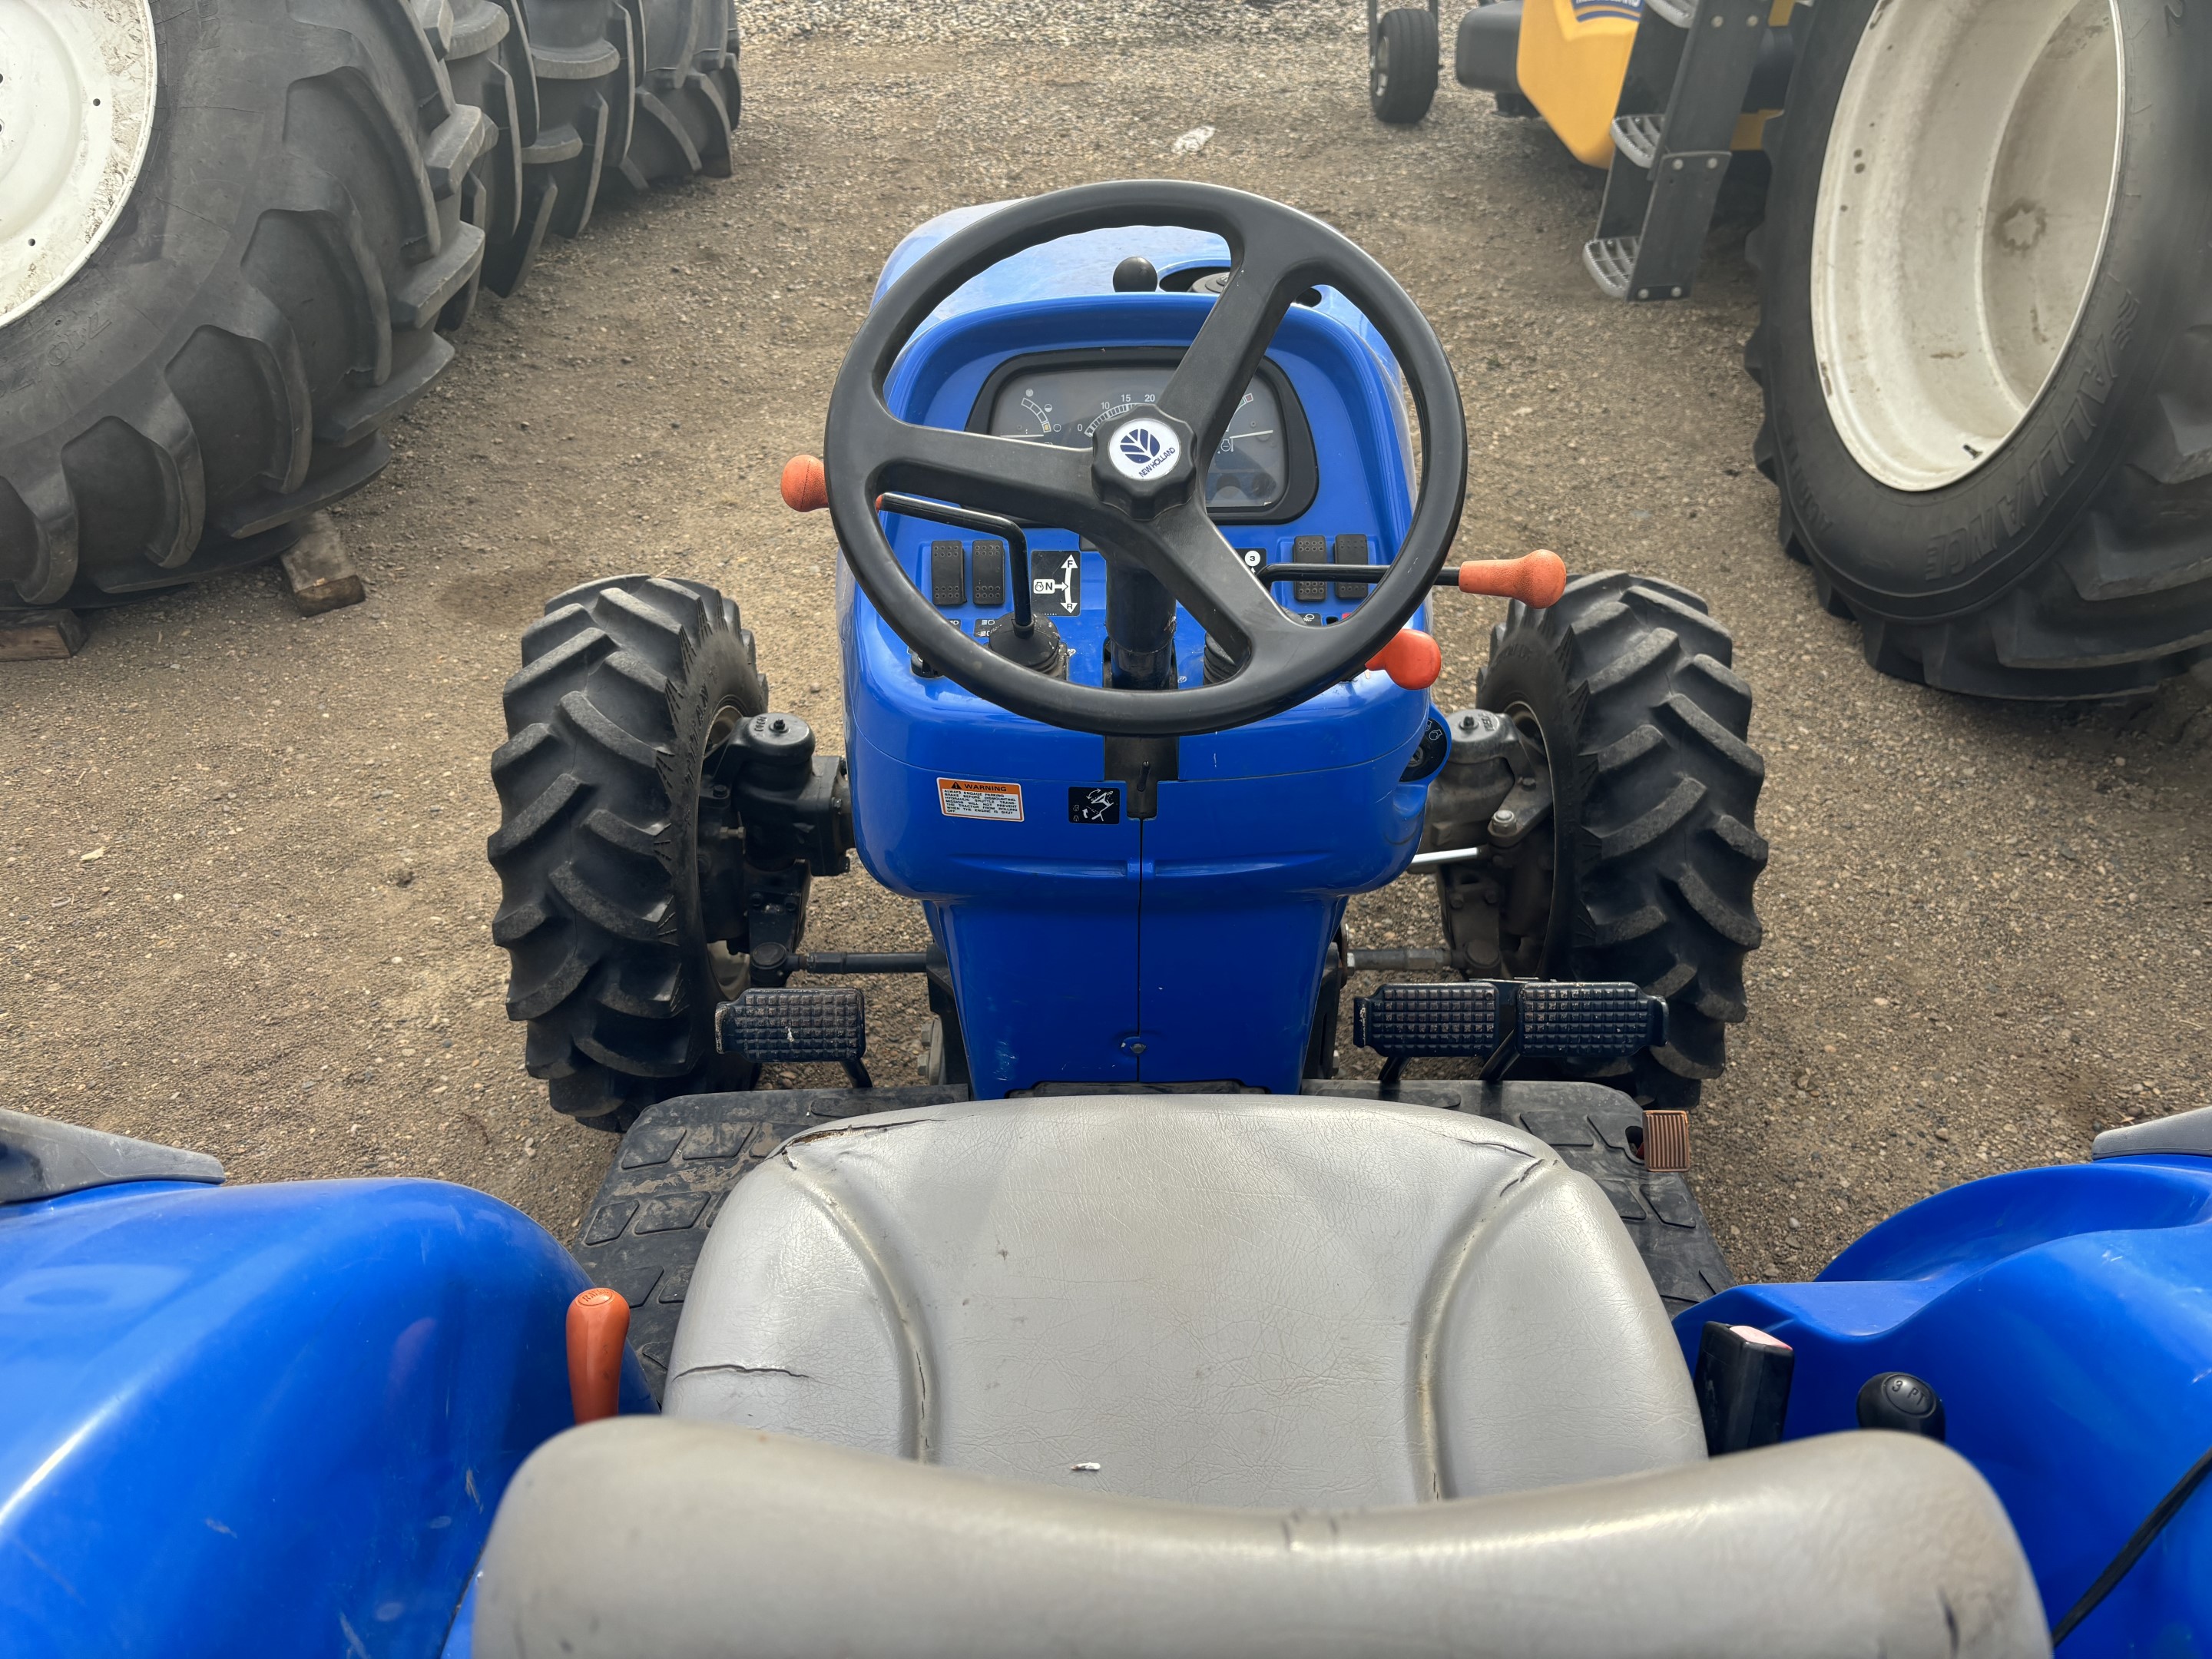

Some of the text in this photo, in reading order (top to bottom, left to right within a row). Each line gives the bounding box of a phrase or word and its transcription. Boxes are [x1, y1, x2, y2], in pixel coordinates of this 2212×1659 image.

[1121, 394, 1131, 402] 15
[1144, 394, 1155, 402] 20
[1077, 423, 1083, 432] 0
[1925, 333, 2118, 581] ALLIANCE
[1139, 447, 1176, 478] NEW HOLLAND
[1067, 560, 1073, 568] F
[1045, 582, 1053, 591] N
[964, 783, 1007, 792] WARNING
[1892, 1380, 1926, 1406] 3 PT
